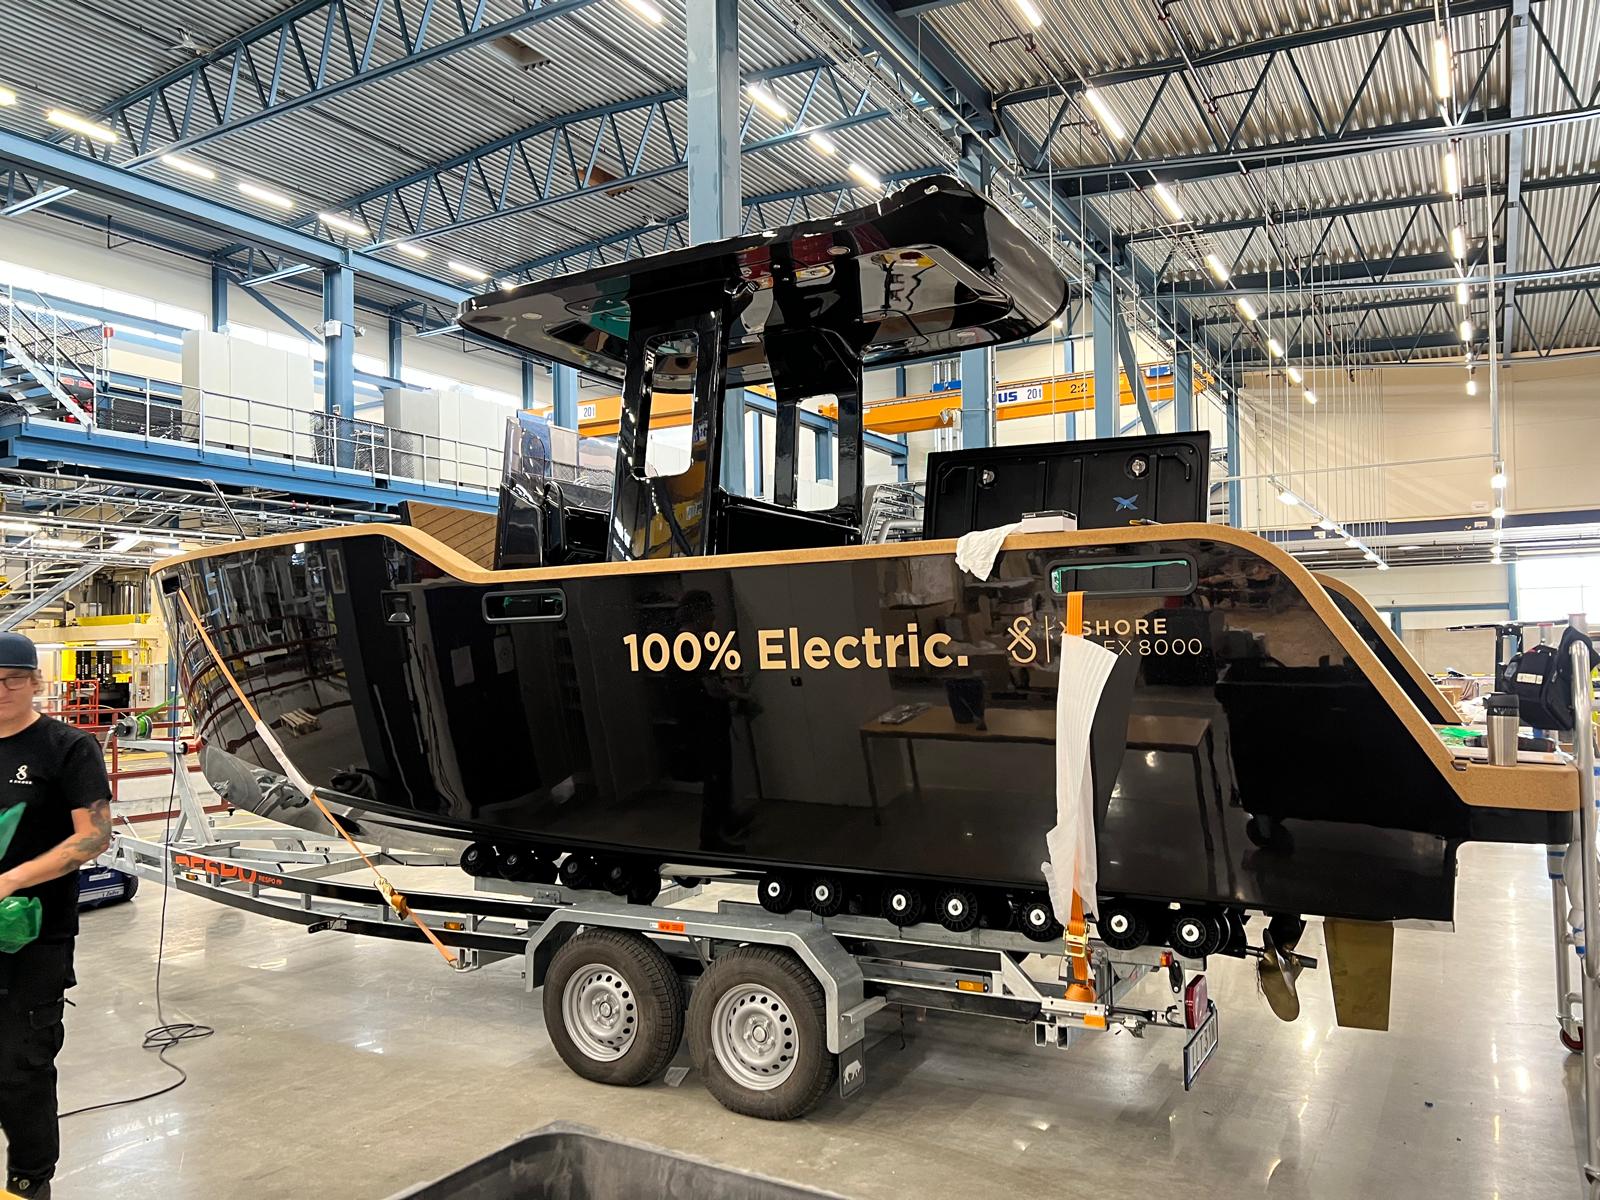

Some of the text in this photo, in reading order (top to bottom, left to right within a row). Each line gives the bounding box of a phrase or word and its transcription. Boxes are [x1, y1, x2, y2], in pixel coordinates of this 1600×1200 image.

[996, 391, 1018, 404] US
[1082, 618, 1168, 636] SHORE
[623, 623, 969, 672] 100% Electric.
[1103, 638, 1203, 656] EX 8000
